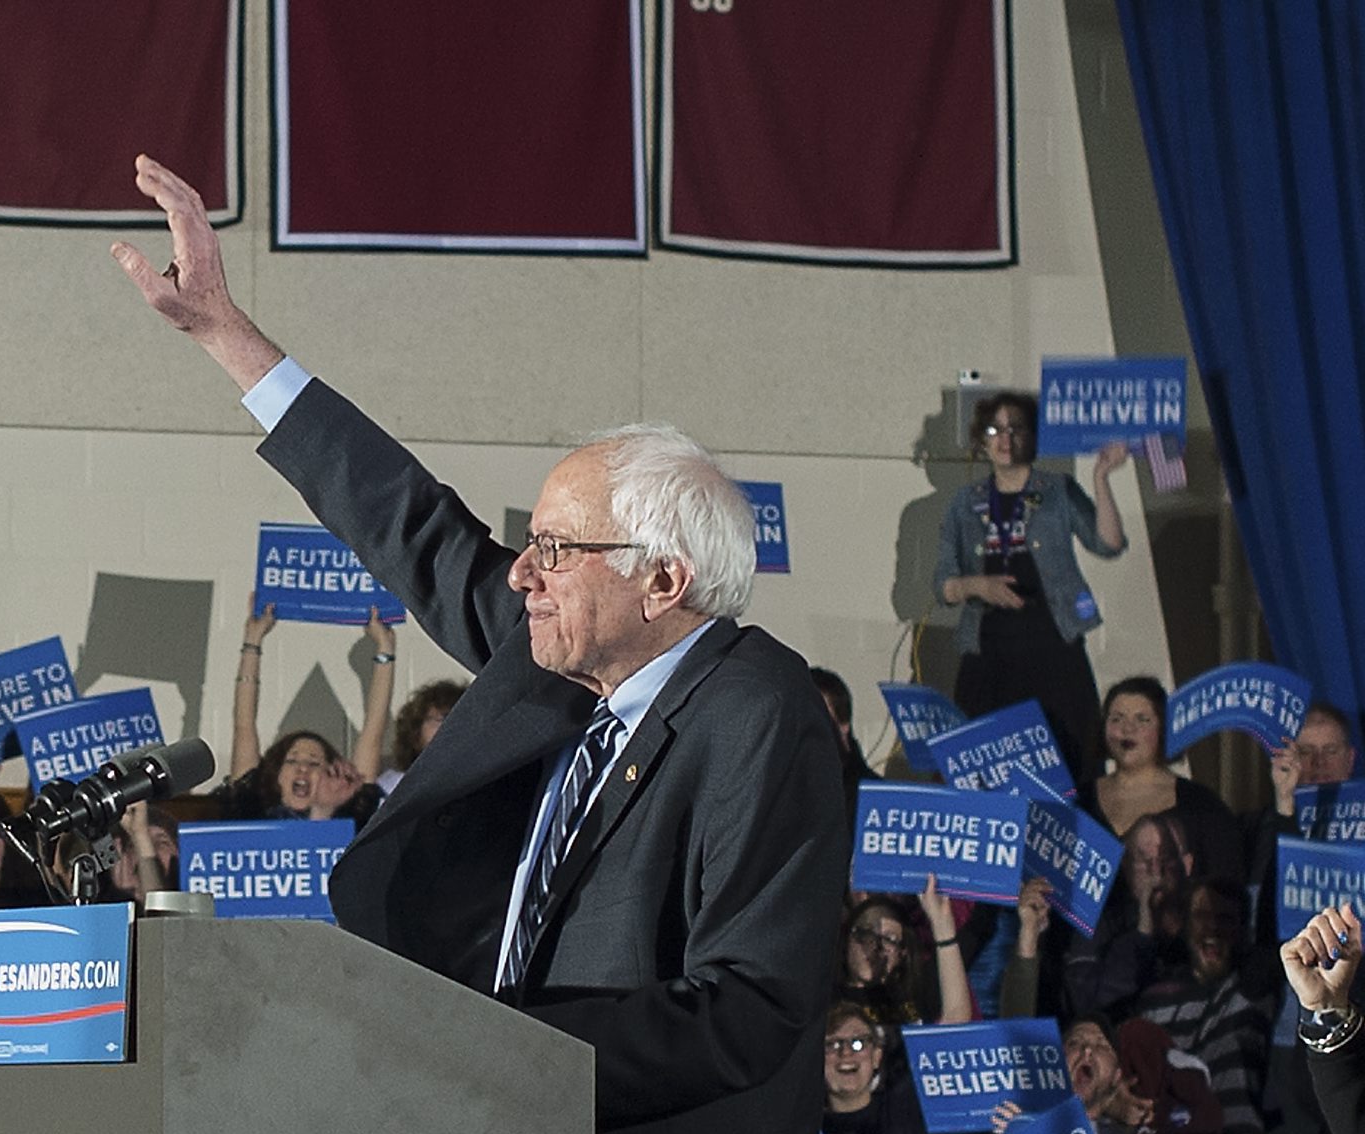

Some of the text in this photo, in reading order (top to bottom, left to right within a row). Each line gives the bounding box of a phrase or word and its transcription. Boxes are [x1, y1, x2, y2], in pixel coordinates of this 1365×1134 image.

[1047, 378, 1181, 401] A FUTURE TO
[1045, 400, 1181, 424] BELIEVE IN
[263, 568, 375, 593] BELIEVE
[1191, 678, 1304, 714] FUTURE TO
[1173, 692, 1300, 736] BELIEVE IN
[48, 720, 130, 751] FUTURE
[961, 736, 1024, 769] FUTURE
[865, 808, 1020, 843] A FUTURE TO
[862, 832, 1017, 868] BELIEVE IN
[1084, 849, 1110, 879] TO
[937, 1045, 1060, 1070] FUTURE TO
[922, 1068, 1066, 1096] BELIEVE IN
